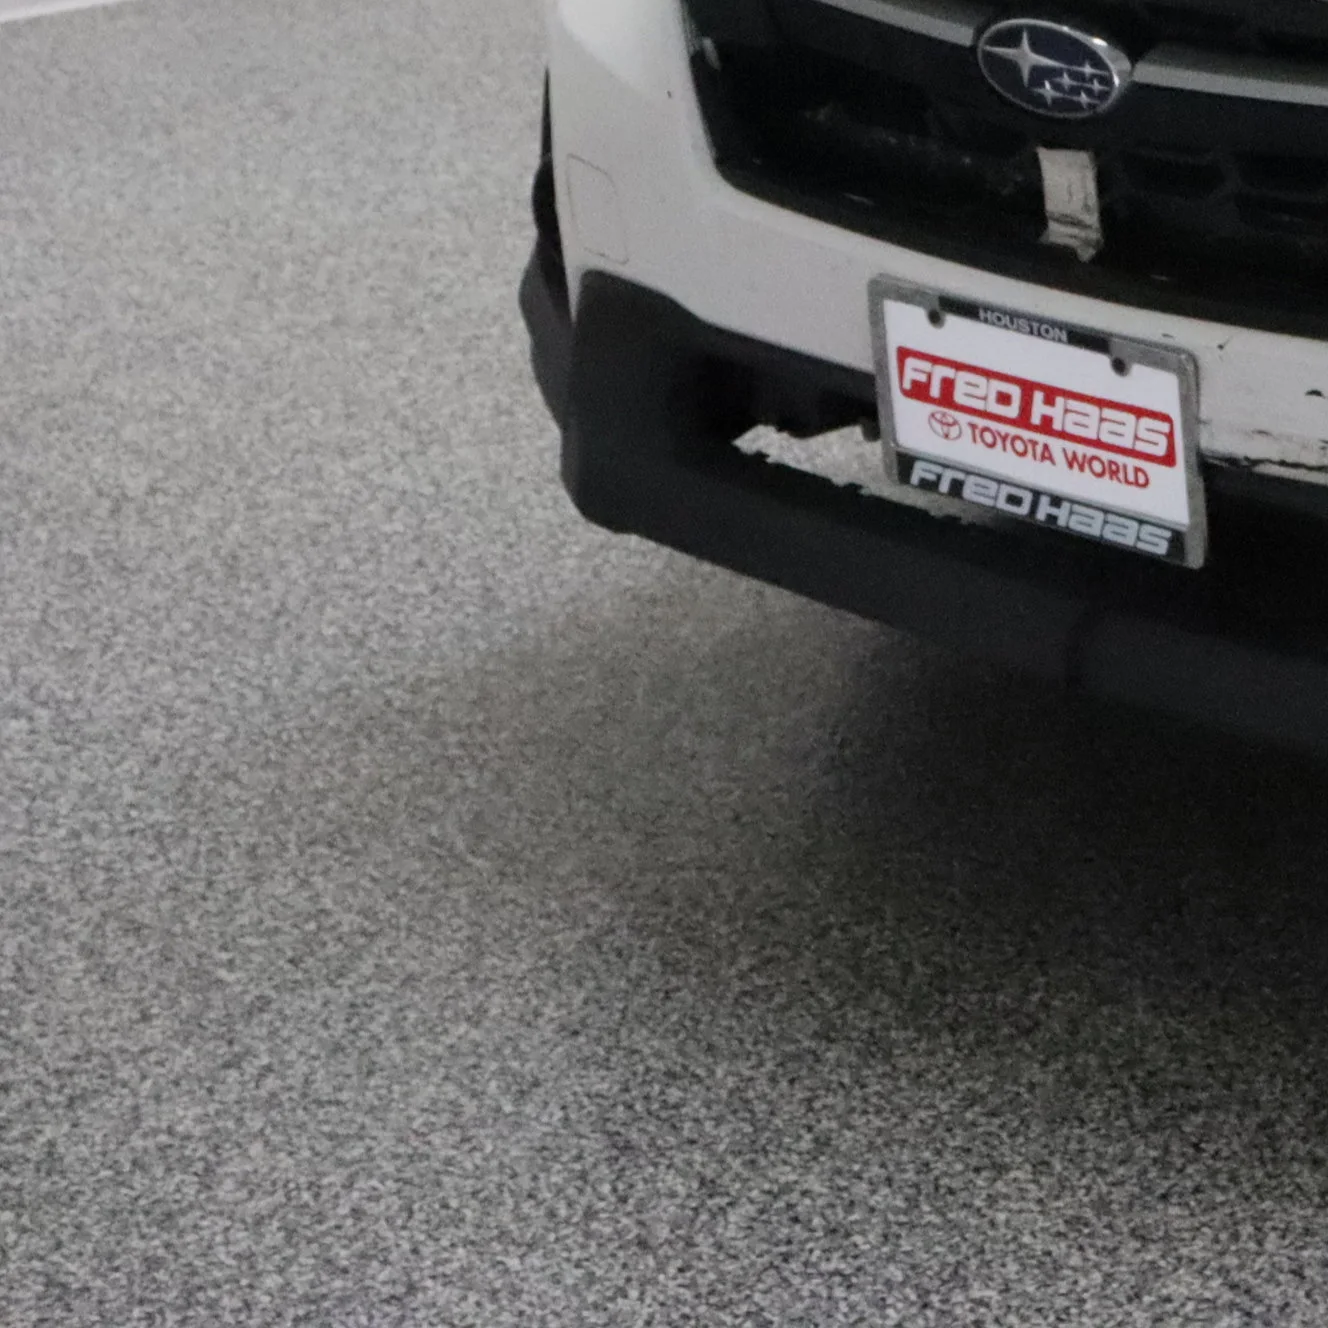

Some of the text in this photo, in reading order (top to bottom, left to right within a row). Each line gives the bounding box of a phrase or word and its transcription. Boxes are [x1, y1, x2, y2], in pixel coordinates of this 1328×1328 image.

[979, 309, 1067, 342] HOUSTON
[968, 422, 1150, 489] TOYOTA WORLD
